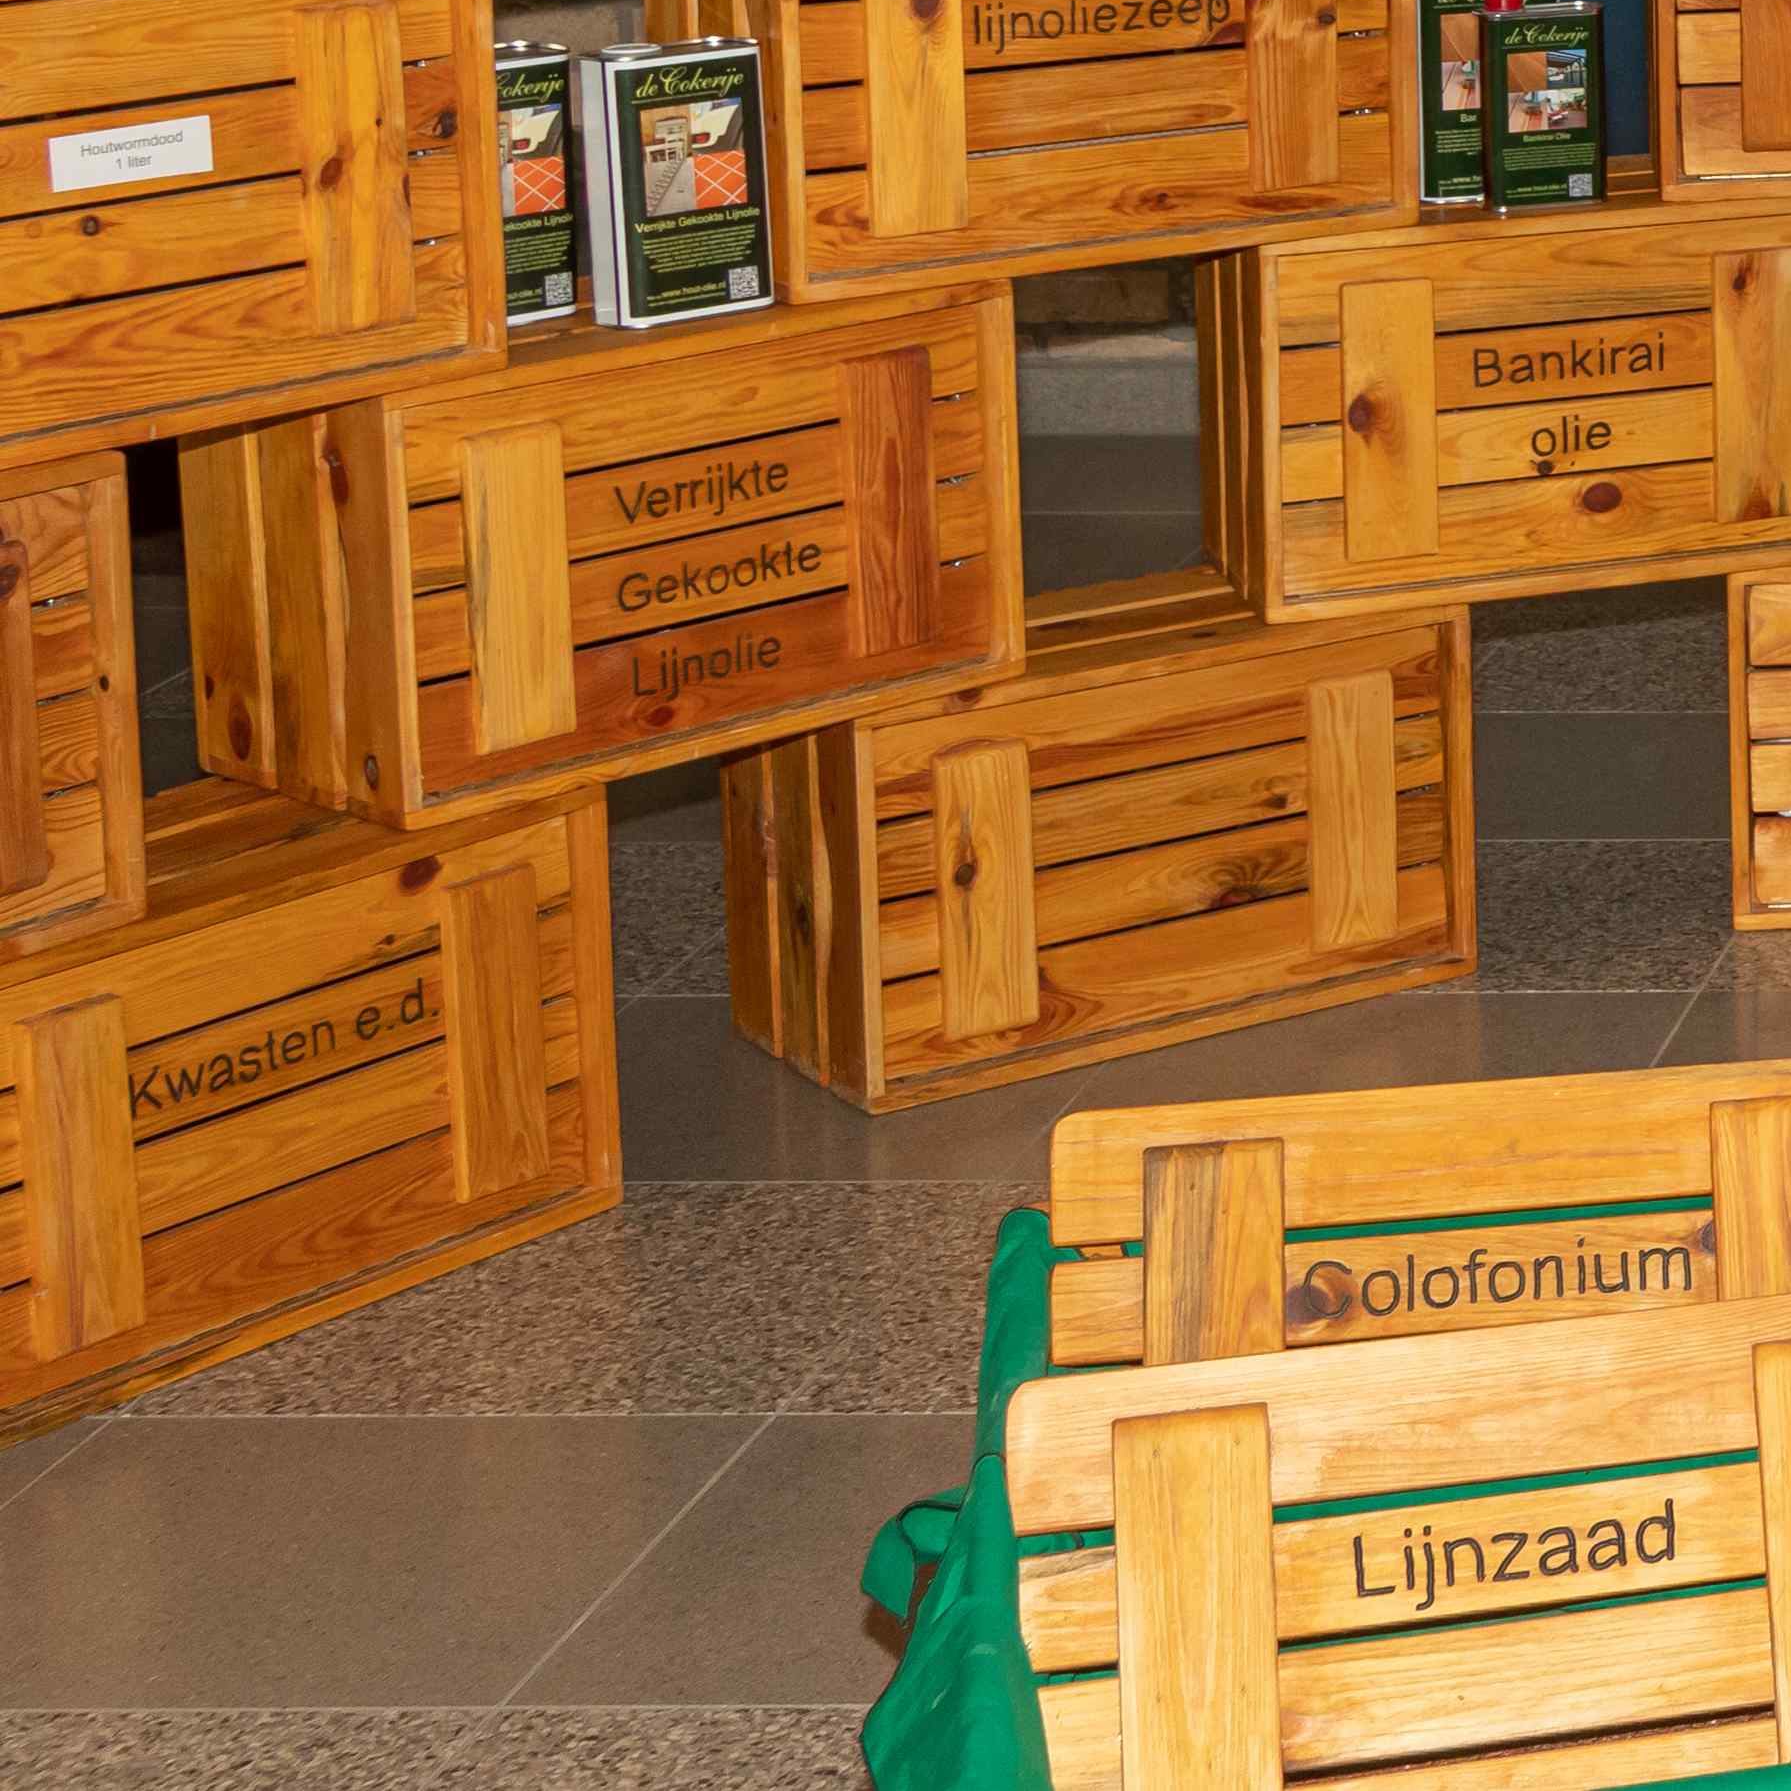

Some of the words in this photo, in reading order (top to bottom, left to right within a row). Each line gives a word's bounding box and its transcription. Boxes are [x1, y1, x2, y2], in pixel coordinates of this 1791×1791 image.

[1504, 27, 1523, 45] de
[636, 74, 658, 97] de
[80, 130, 183, 157] Houtwormdood
[115, 158, 122, 169] 1
[128, 156, 152, 168] liter
[504, 219, 542, 233] ekookte
[678, 213, 724, 228] Gekookte
[725, 207, 761, 221] Lijnolie
[1473, 332, 1666, 387] Bankirai
[1531, 415, 1613, 457] olie
[614, 462, 789, 524] Verrijkte
[617, 542, 822, 614] Gekookte
[631, 633, 782, 702] Lijnolie
[128, 1020, 335, 1120] Kwasten
[354, 979, 441, 1039] e.d.
[1301, 1243, 1693, 1320] Colofonium
[1353, 1500, 1677, 1610] Lijnzaad
